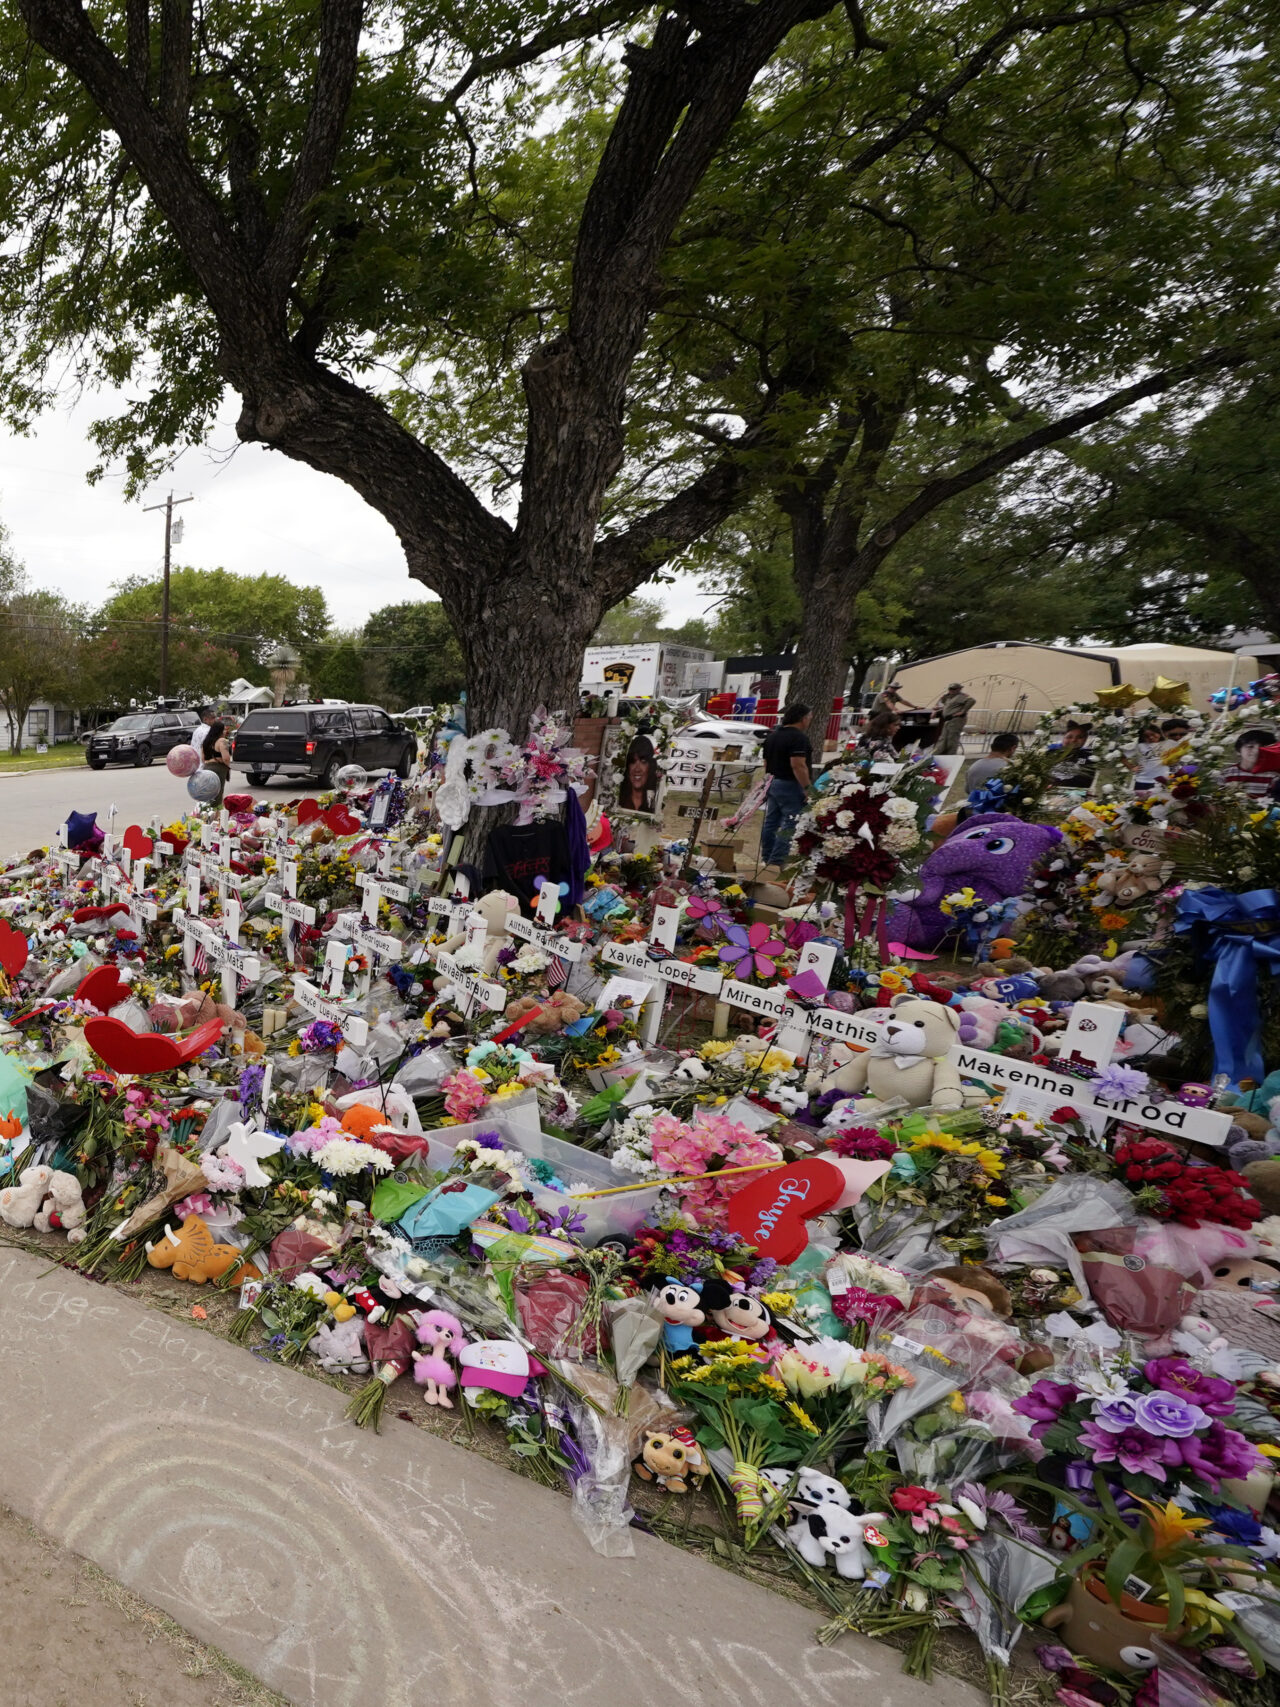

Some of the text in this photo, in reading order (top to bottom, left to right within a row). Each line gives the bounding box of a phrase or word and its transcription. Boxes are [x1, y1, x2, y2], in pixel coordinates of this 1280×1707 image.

[269, 897, 302, 918] Lexi Rubio
[431, 901, 447, 912] Jose
[361, 930, 390, 952] Rodriguez
[535, 931, 570, 955] Ramirez
[210, 941, 244, 971] Tess Mata
[608, 947, 697, 984] Xavier Lopez
[300, 990, 317, 1008] Jayce
[465, 972, 491, 1002] Bravo
[726, 986, 878, 1045] Miranda Mathis
[956, 1053, 1076, 1097] Makenna
